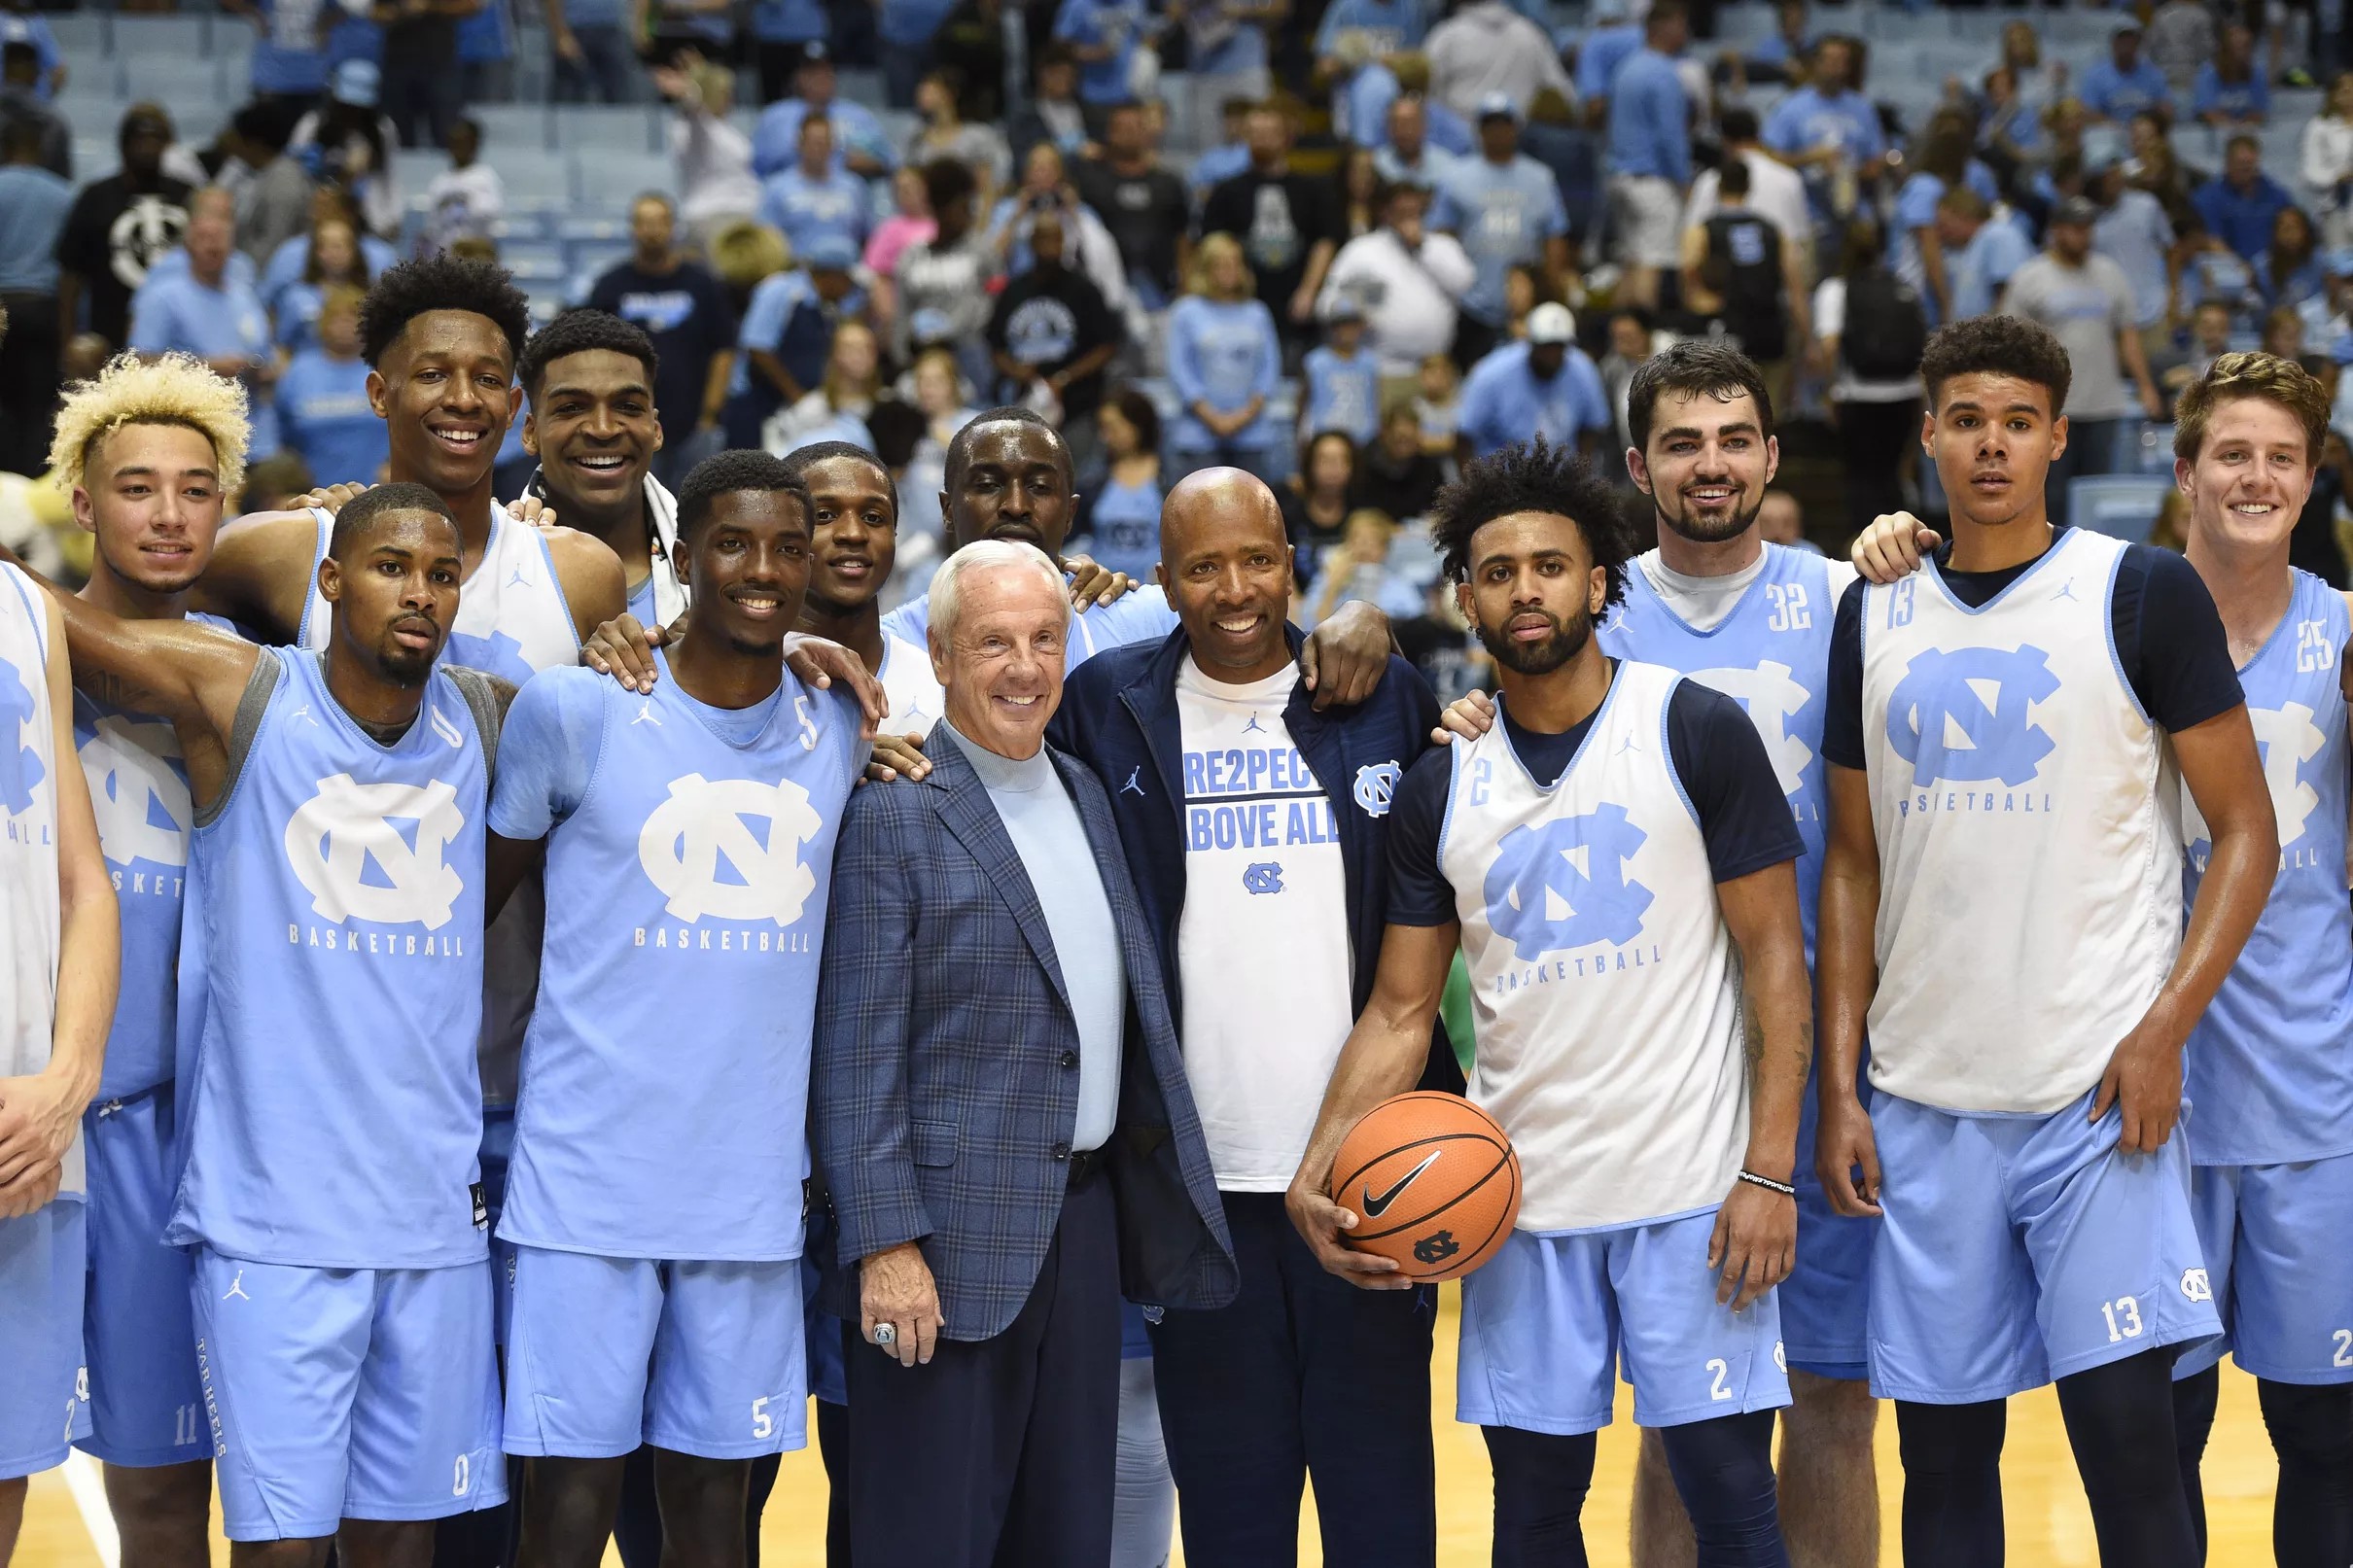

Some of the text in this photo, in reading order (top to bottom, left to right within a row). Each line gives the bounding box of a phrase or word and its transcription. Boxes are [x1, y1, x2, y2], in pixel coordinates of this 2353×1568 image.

[1766, 583, 1812, 632] 32
[1886, 576, 1916, 630] 13
[2297, 618, 2334, 673] 25
[795, 696, 818, 751] 5
[1183, 748, 1325, 795] RE2PEC
[1469, 757, 1493, 808] 2
[1185, 801, 1340, 852] BOVE ALL
[289, 923, 464, 957] BASKETBALL
[635, 927, 809, 954] BASKETBALL
[1496, 944, 1662, 994] BASKETBALL
[2101, 1296, 2143, 1342] 13
[2333, 1329, 2353, 1368] 2
[196, 1338, 227, 1458] TAR HEELS
[1705, 1358, 1732, 1400] 2
[174, 1403, 197, 1446] 11
[752, 1396, 772, 1439] 5
[453, 1453, 469, 1497] 0
